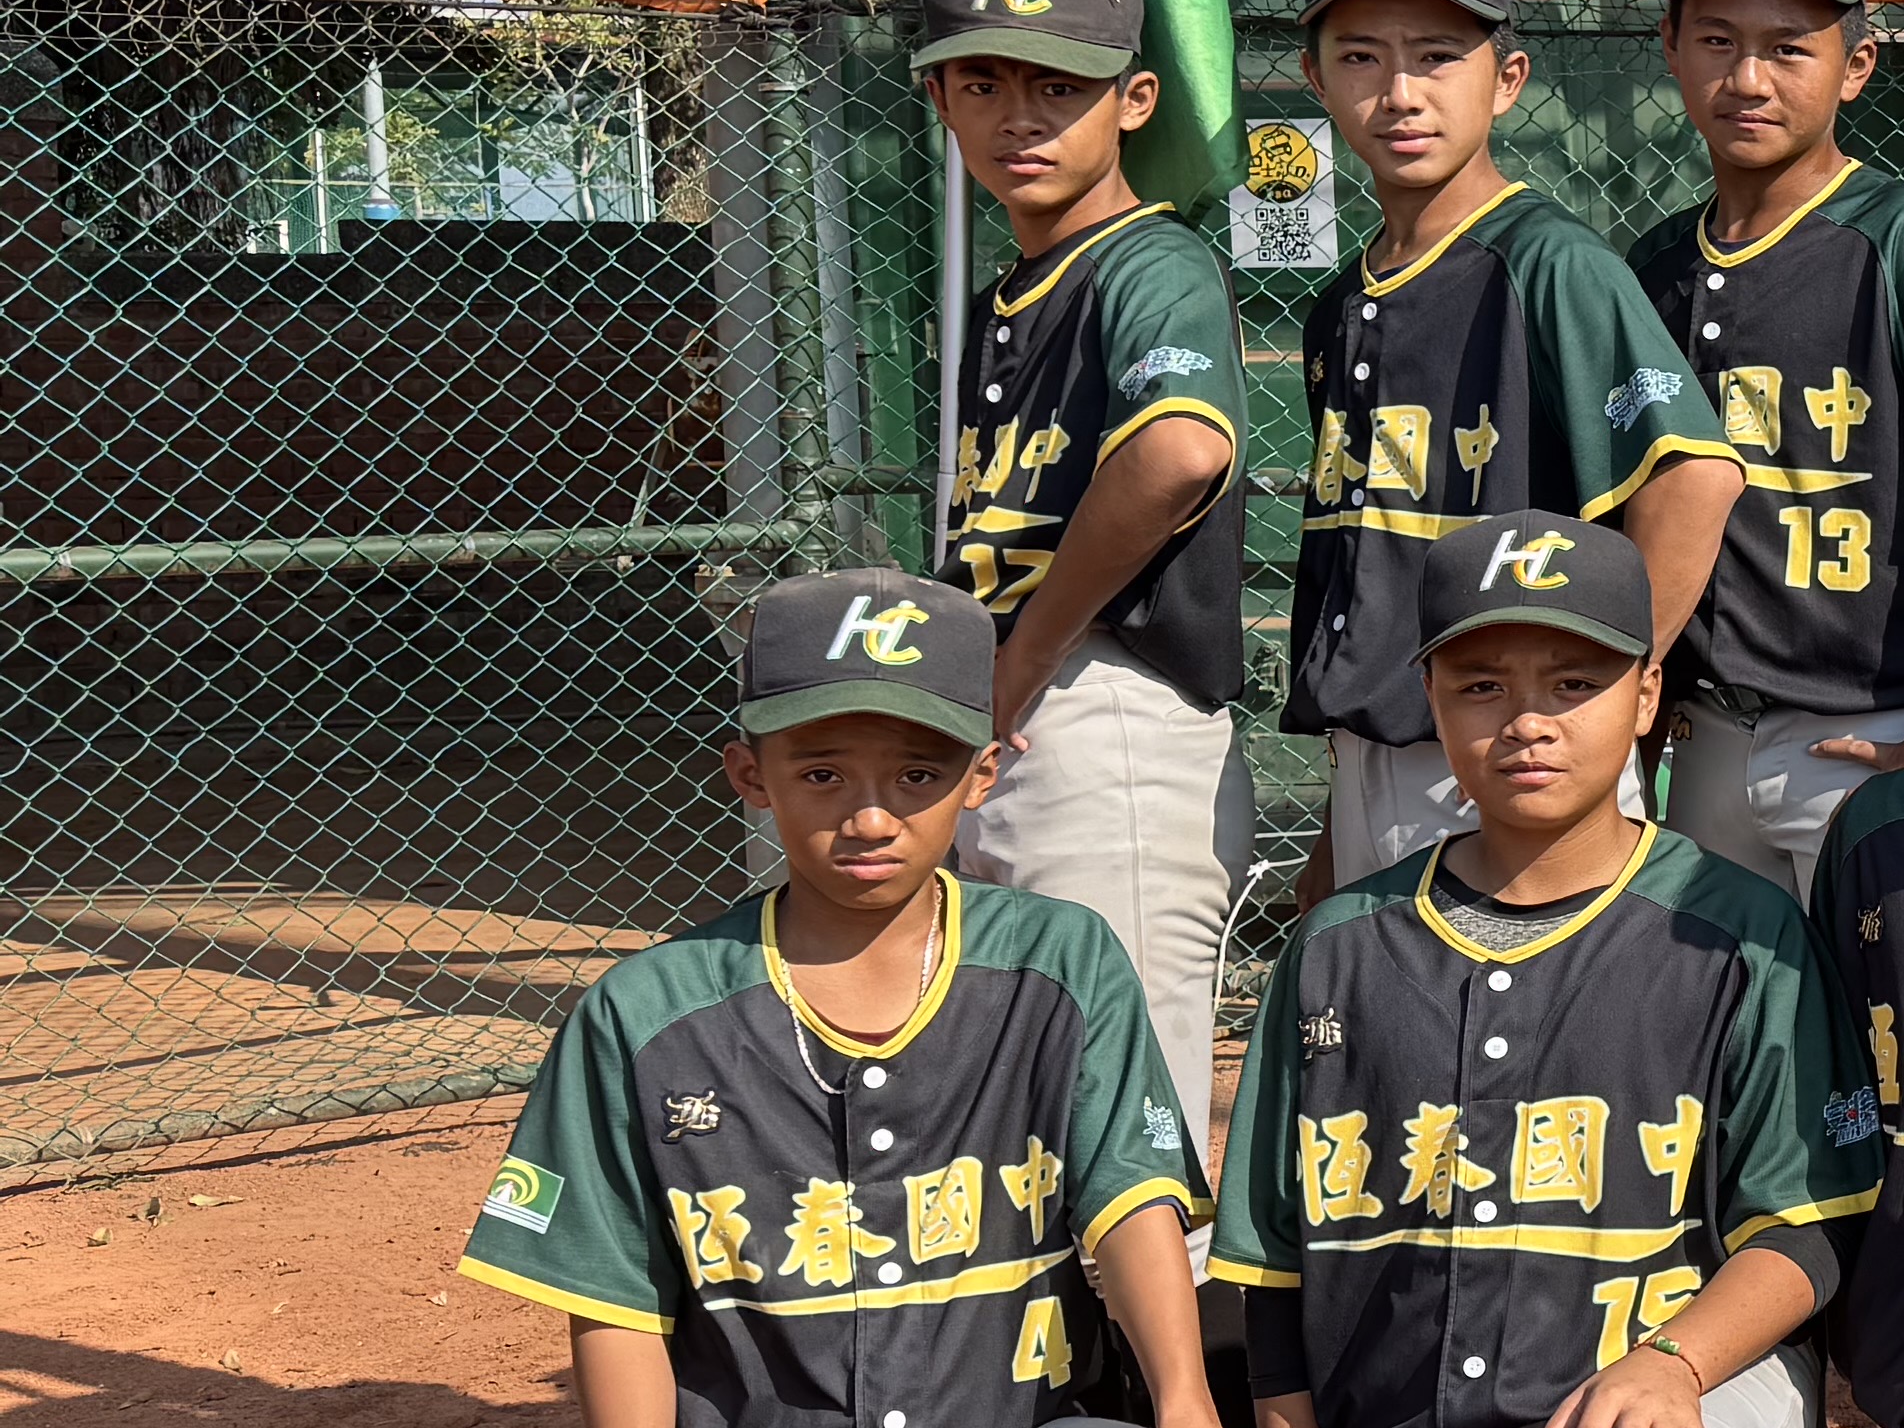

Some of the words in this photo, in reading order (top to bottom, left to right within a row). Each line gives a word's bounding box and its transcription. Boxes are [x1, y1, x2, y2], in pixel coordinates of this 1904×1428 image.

[959, 542, 1056, 614] 17
[1778, 506, 1871, 592] 13
[1297, 1094, 1703, 1226] 恆春國中
[668, 1135, 1063, 1289] 恆春國中
[1012, 1295, 1072, 1390] 4
